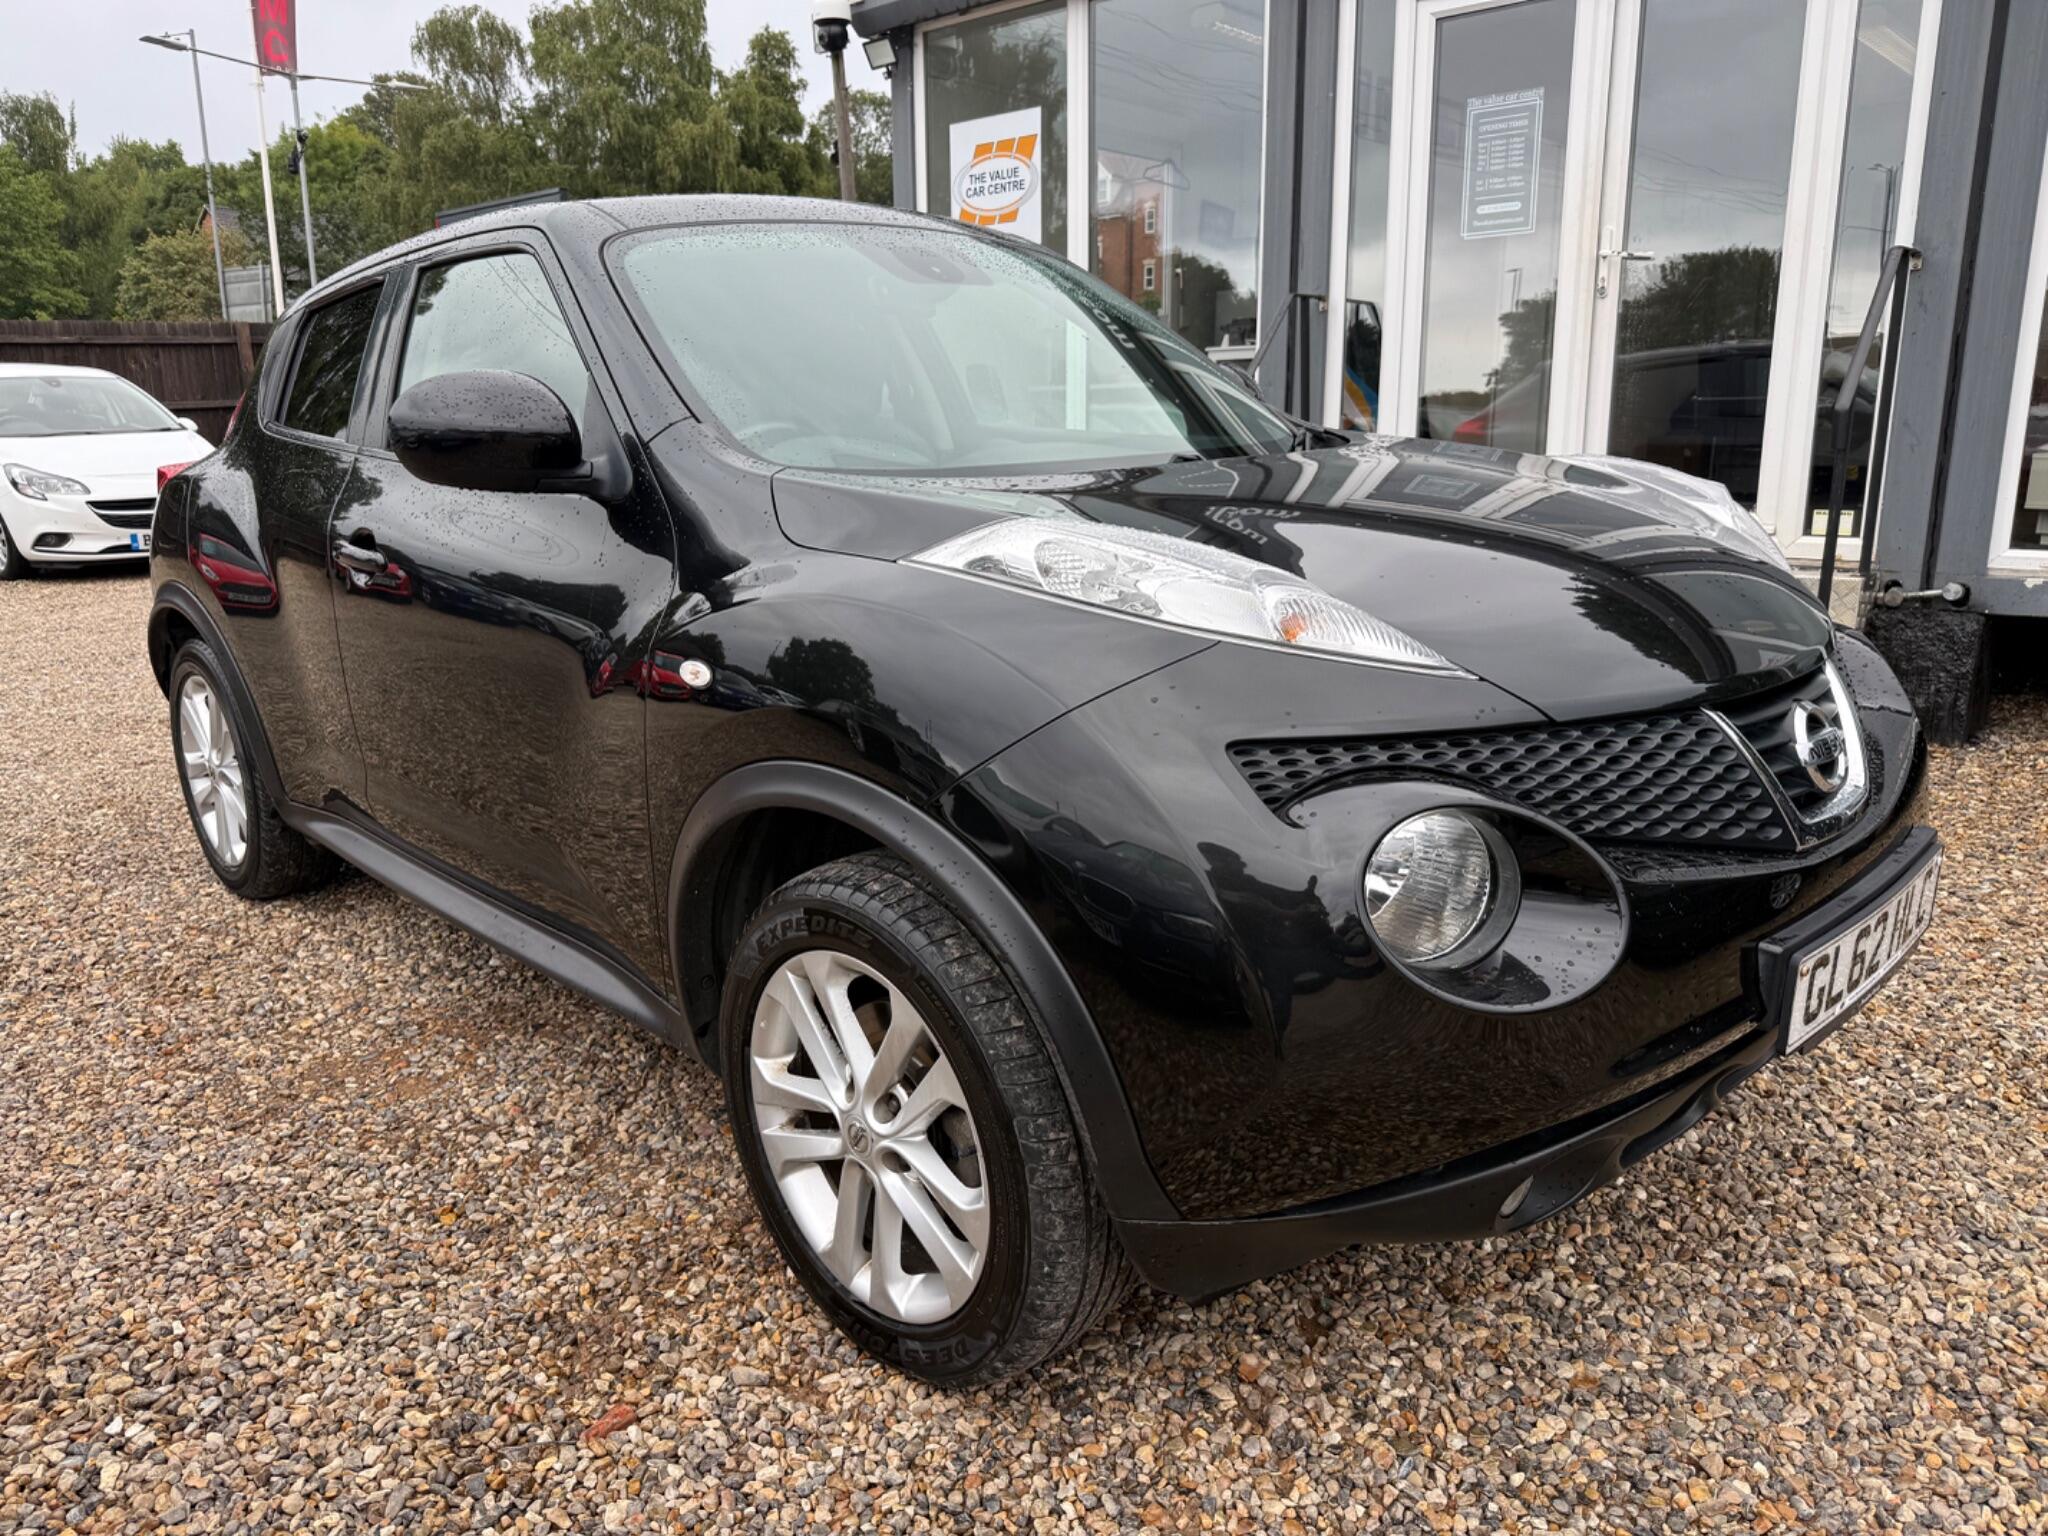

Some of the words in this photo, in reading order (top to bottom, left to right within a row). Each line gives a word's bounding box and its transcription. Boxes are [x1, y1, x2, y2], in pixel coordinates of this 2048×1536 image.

[969, 172, 987, 185] THE
[988, 166, 1019, 181] VALUE
[966, 186, 985, 198] CAR
[987, 178, 1025, 195] CENTRE
[1803, 909, 1890, 1026] GL62
